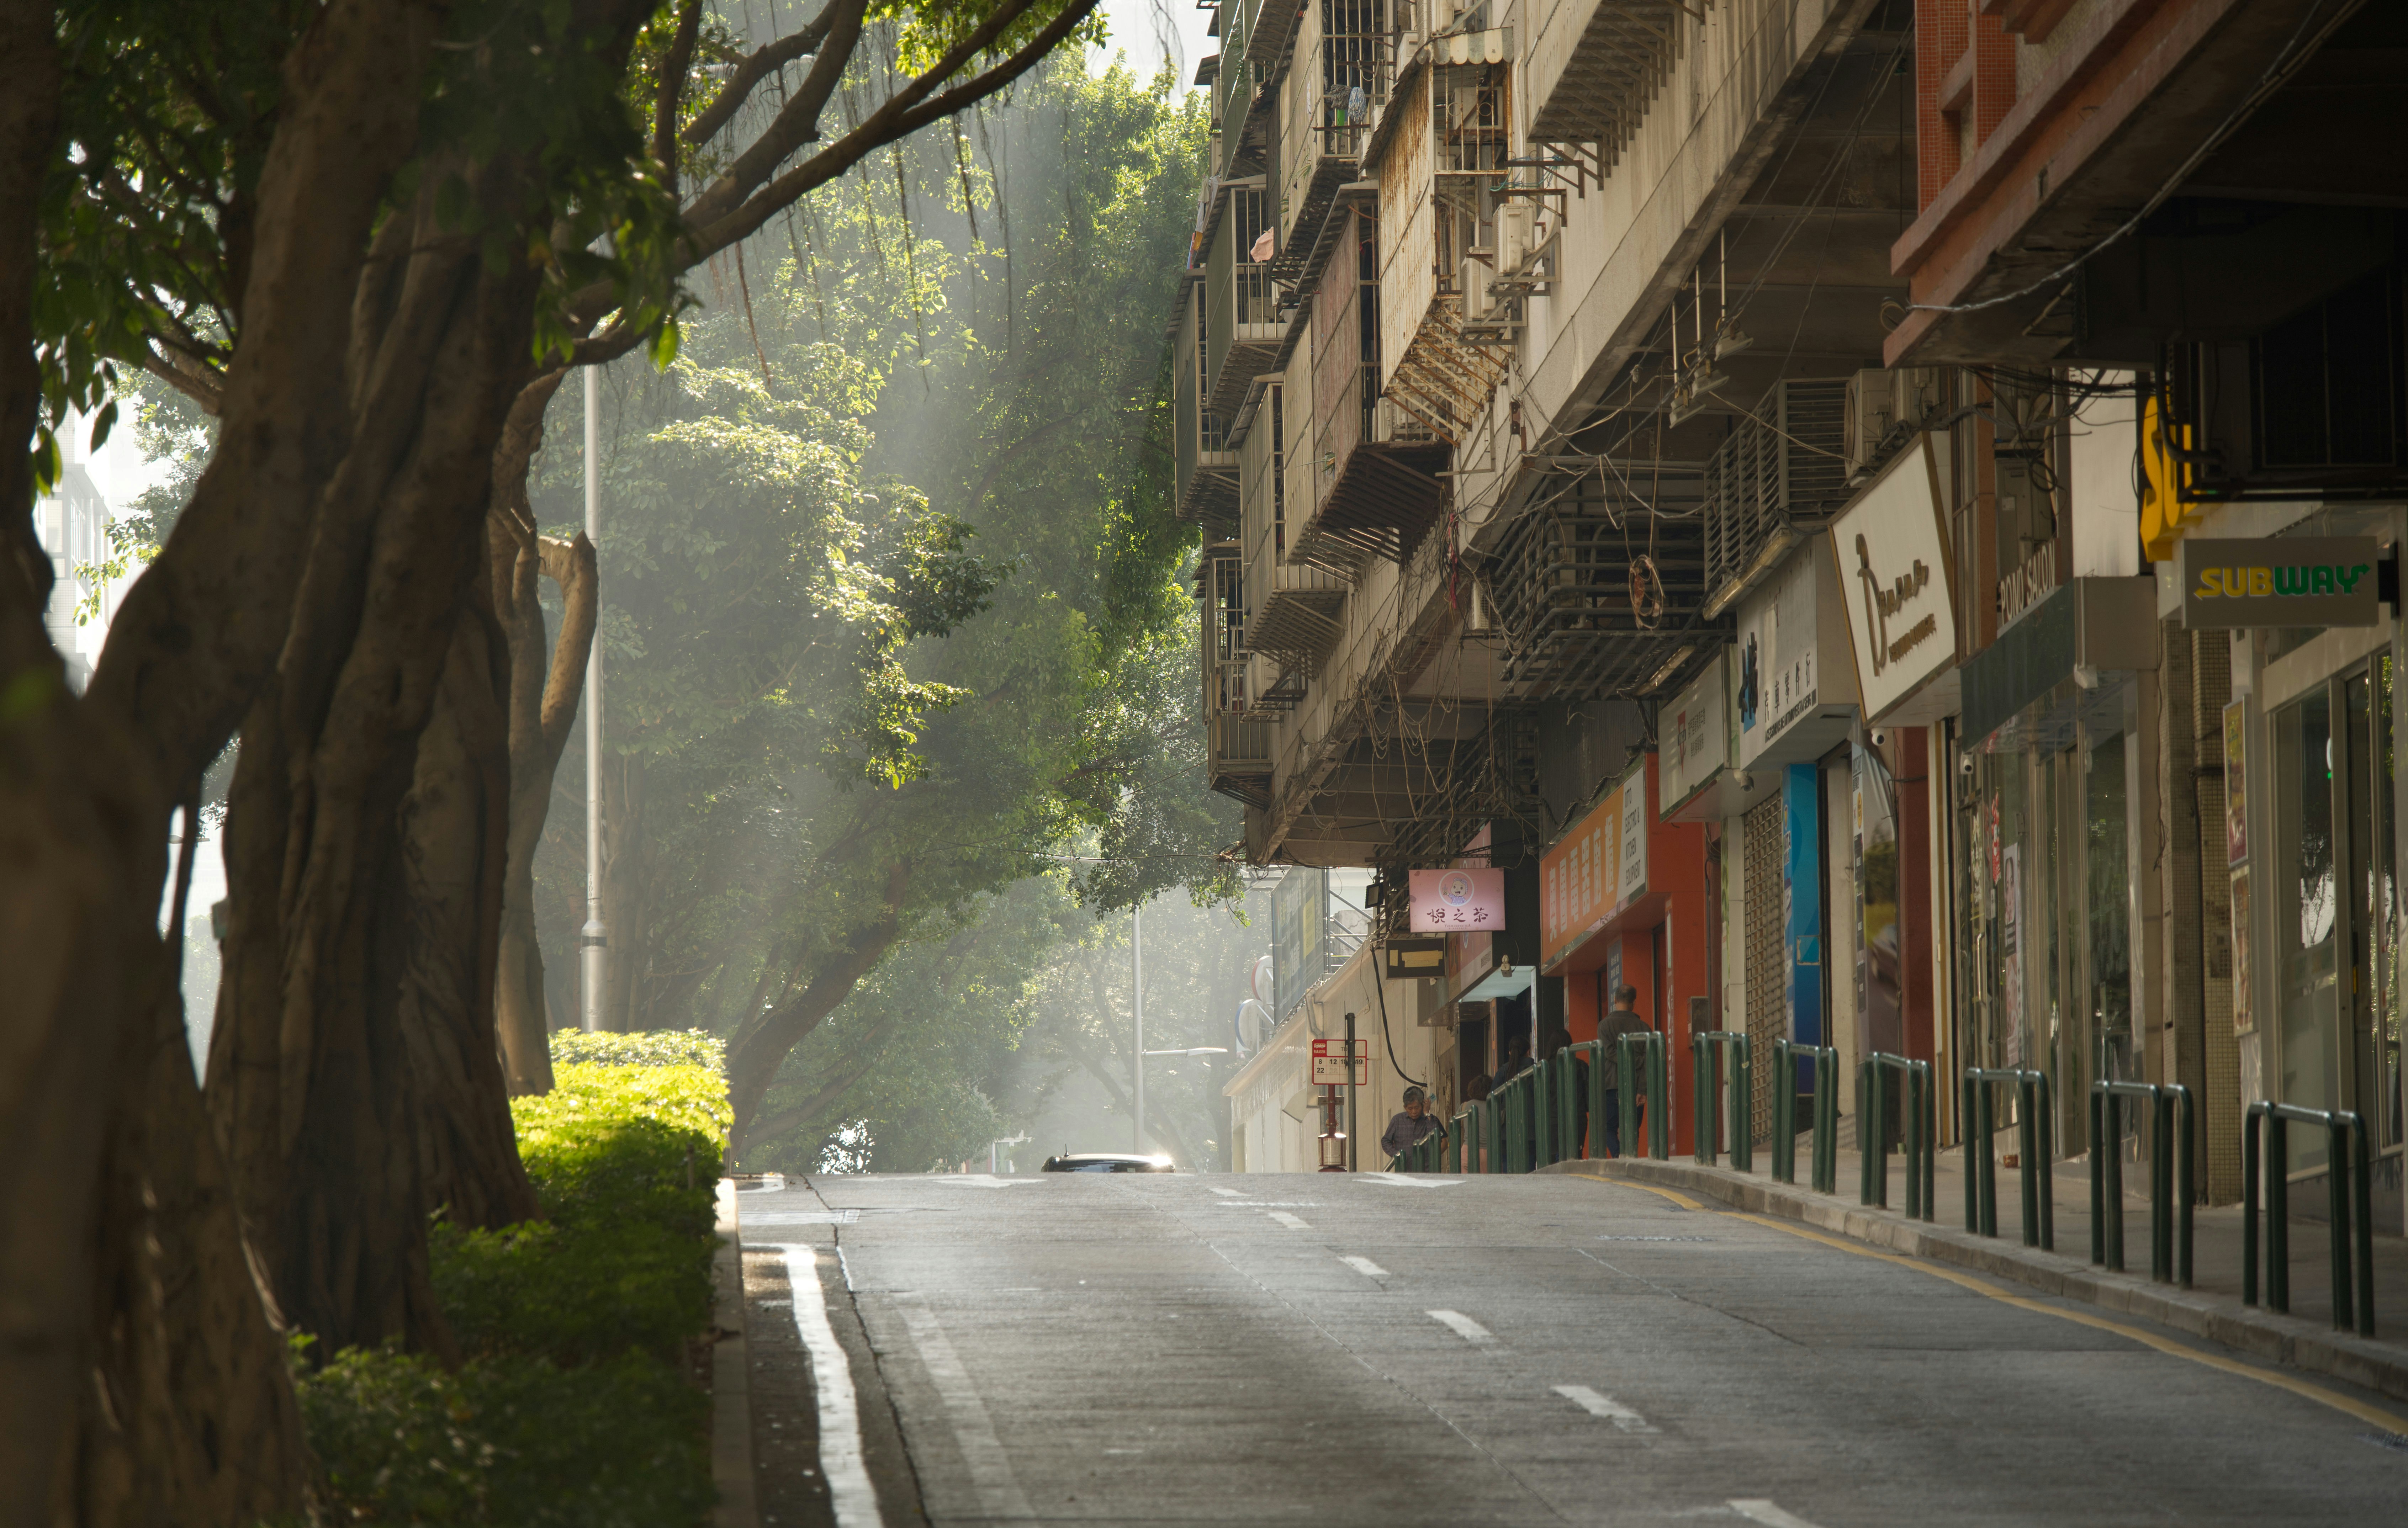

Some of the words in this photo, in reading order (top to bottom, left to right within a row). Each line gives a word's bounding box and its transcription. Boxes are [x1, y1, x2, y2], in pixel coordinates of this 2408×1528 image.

[2001, 565, 2024, 626] PONO
[2027, 539, 2055, 606] SALON
[2194, 563, 2370, 600] SUBWAY
[1764, 651, 1810, 723] 汽車零件行
[1625, 809, 1636, 834] ELECTRIC
[1626, 837, 1636, 861] KITCHEN
[1626, 859, 1641, 886] EQUIPMENT
